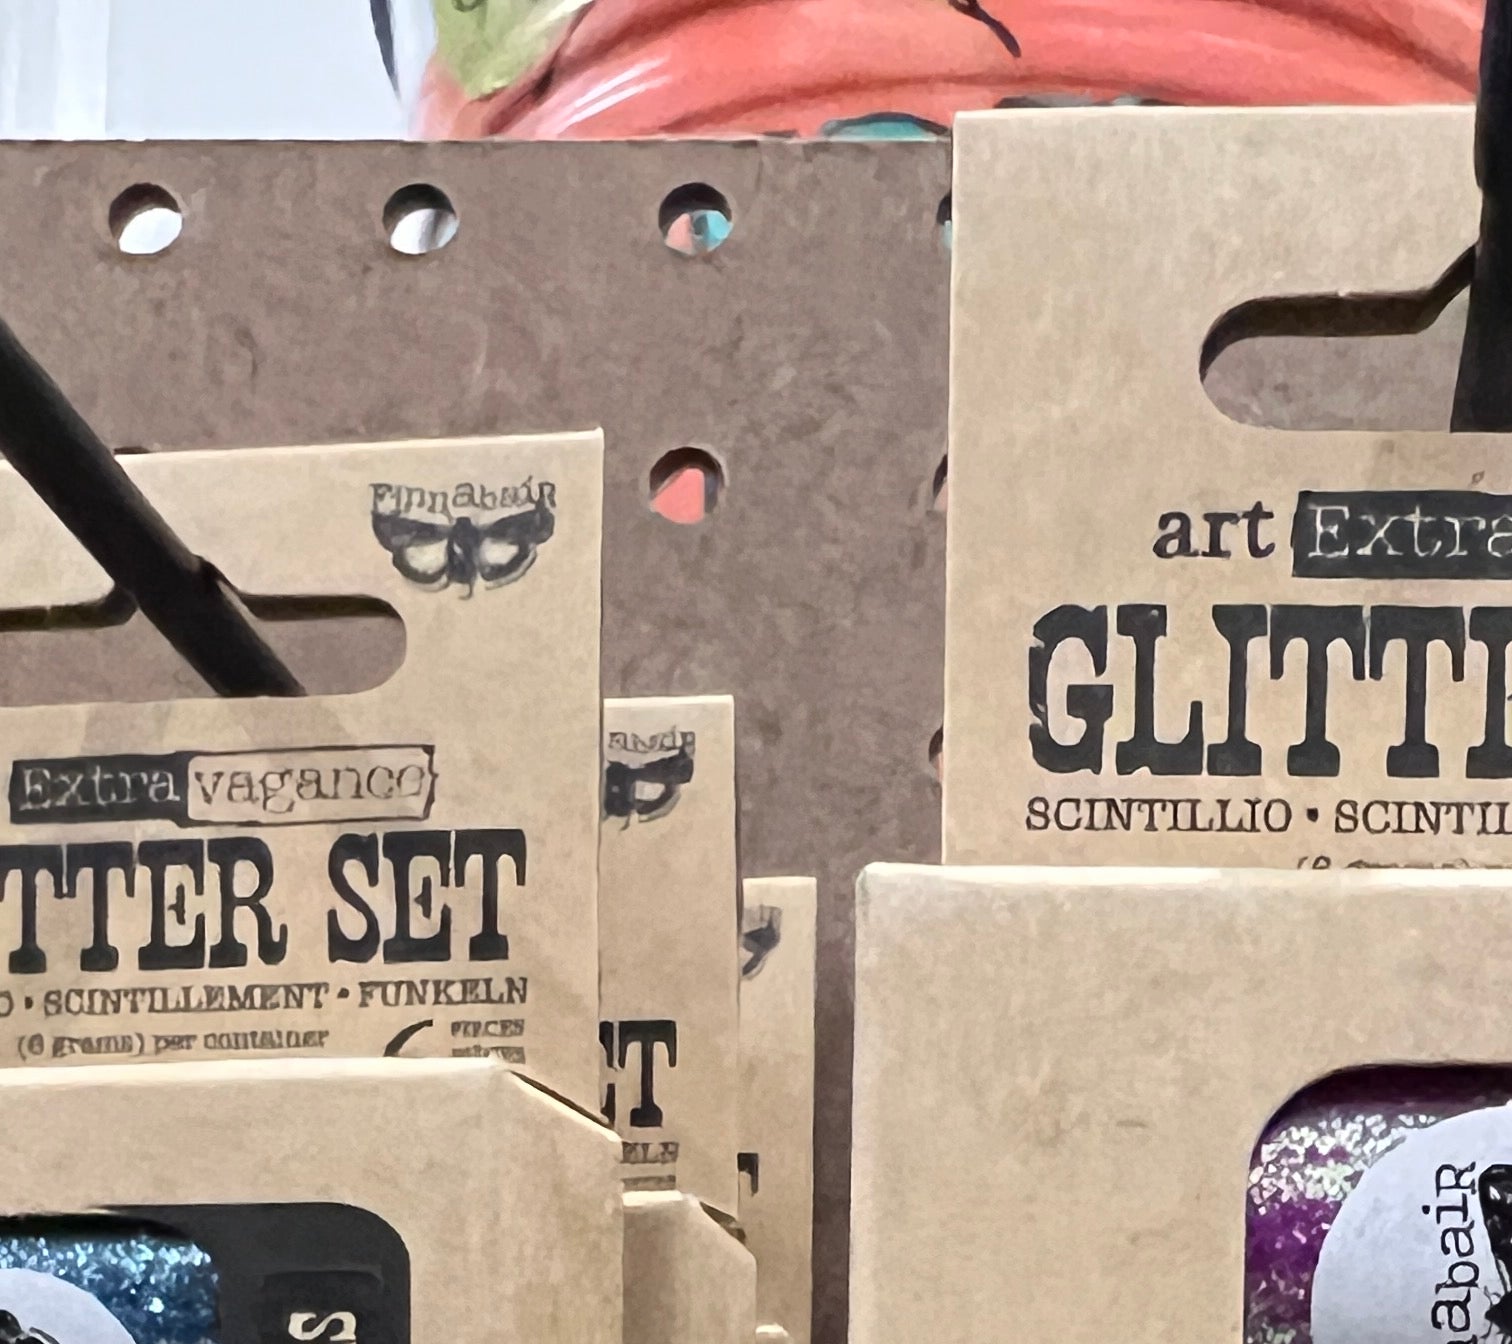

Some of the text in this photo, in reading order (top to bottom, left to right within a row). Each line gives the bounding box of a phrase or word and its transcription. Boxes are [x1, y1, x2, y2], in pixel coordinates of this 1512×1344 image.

[1151, 502, 1275, 561] art
[1024, 797, 1294, 835] SCINTILLIO
[328, 829, 527, 964] SET
[43, 982, 330, 1016] SCINTILLEMENT
[359, 976, 529, 1005] FUNKELN
